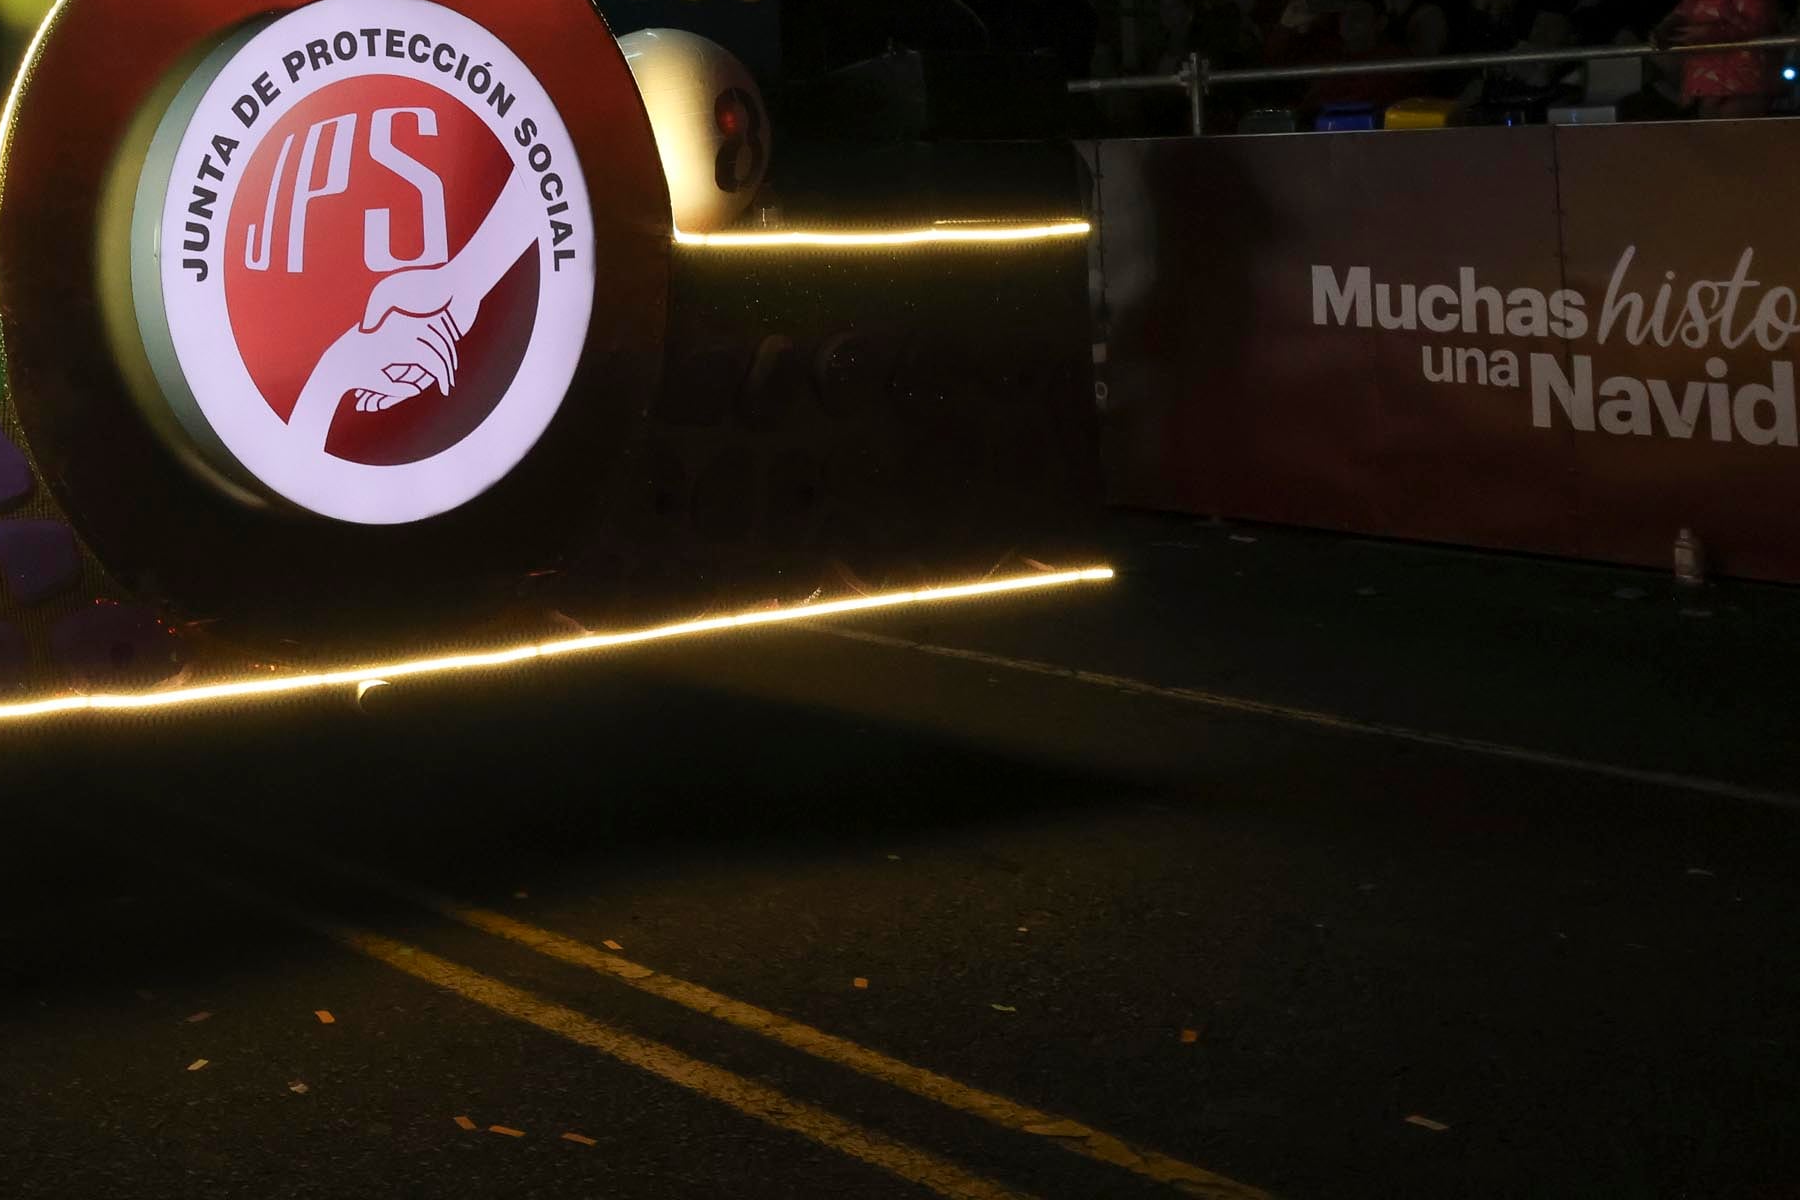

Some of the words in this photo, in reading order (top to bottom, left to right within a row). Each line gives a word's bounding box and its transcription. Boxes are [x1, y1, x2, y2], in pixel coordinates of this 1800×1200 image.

[182, 135, 239, 282] JUNTA
[231, 71, 282, 128] DE
[282, 28, 517, 119] PROTECCIÓN
[513, 117, 576, 273] SOCIAL
[245, 107, 449, 274] JPS
[1311, 264, 1588, 340] Muchas
[1421, 344, 1521, 388] una
[1530, 351, 1800, 448] Navid
